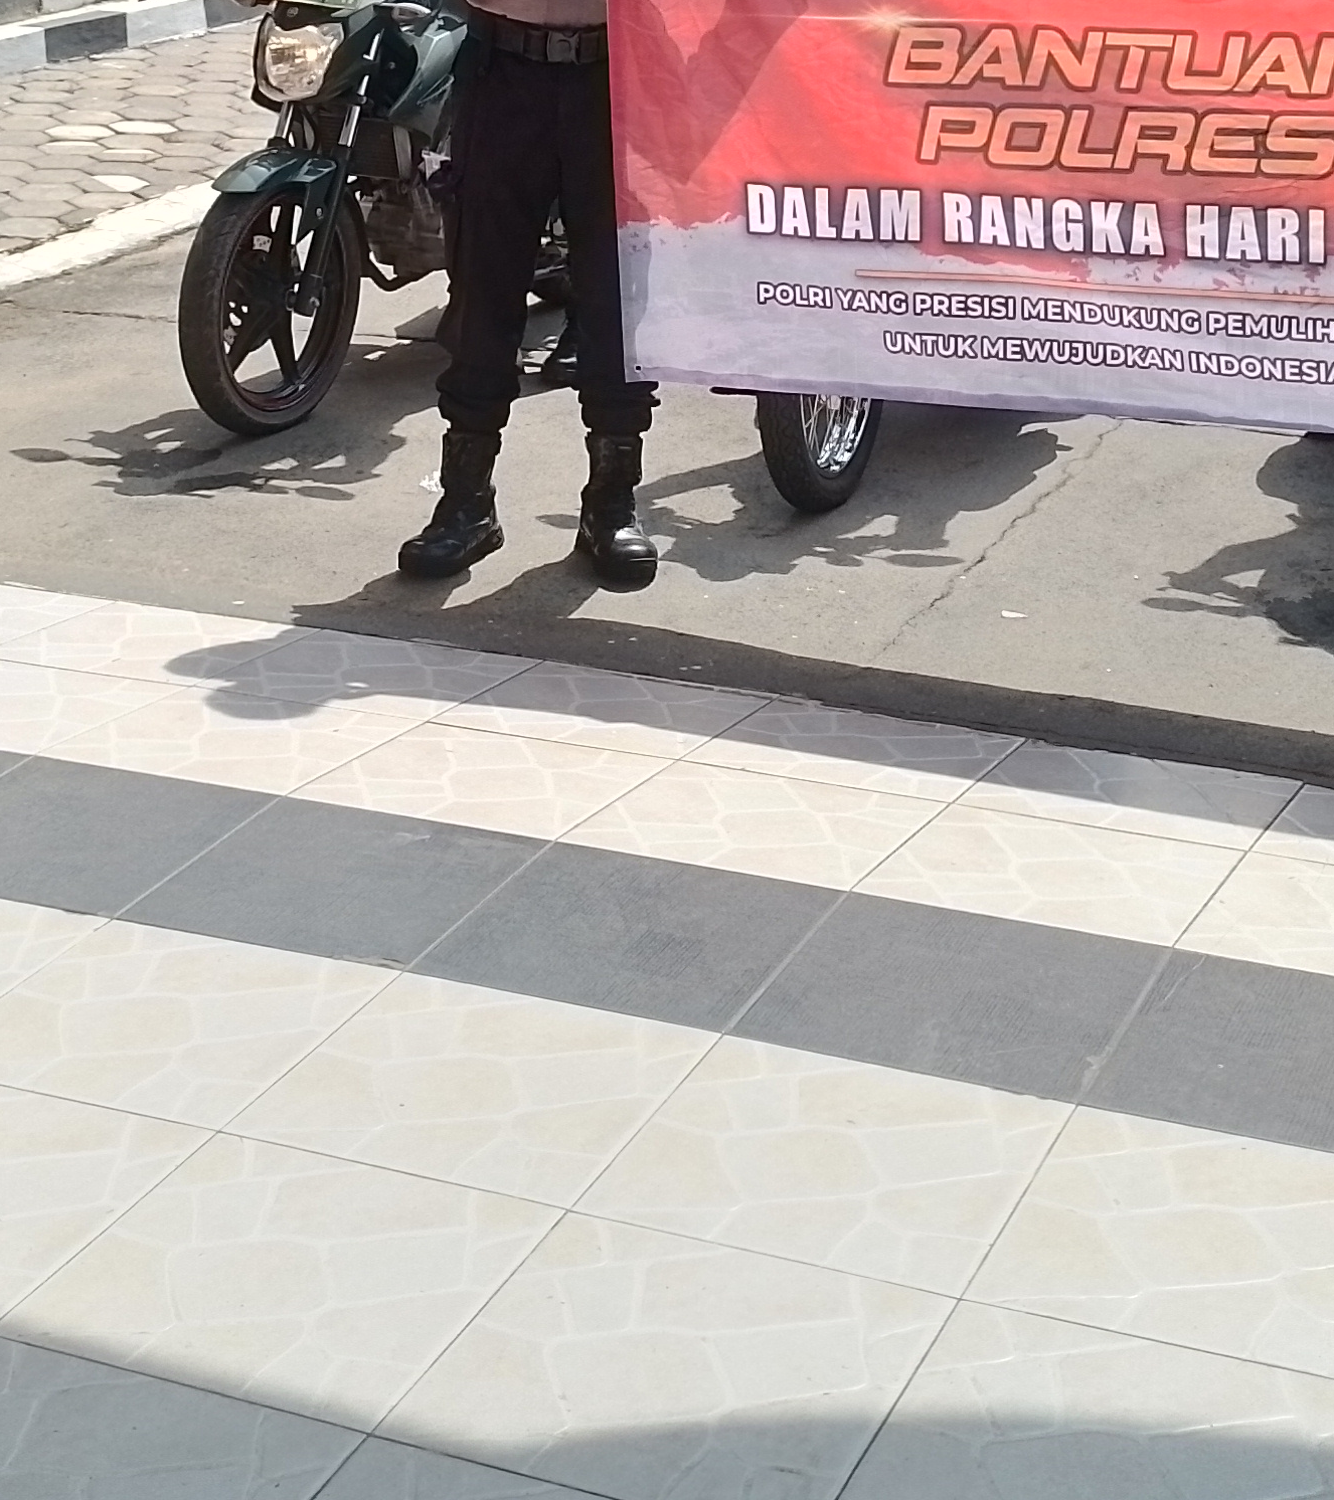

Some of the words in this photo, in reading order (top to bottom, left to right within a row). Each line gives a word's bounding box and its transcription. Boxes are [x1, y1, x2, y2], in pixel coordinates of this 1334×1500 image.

[745, 182, 923, 243] DALAM
[942, 190, 1168, 257] RANGKA
[1185, 203, 1326, 264] HARI
[757, 281, 833, 309] POLRI
[835, 287, 908, 315] YANG
[914, 292, 1017, 320] PRESISI
[1022, 297, 1202, 336] MENDUKUNG
[883, 329, 978, 360] UNTUK
[980, 335, 1184, 372] MEWUJUDKAN
